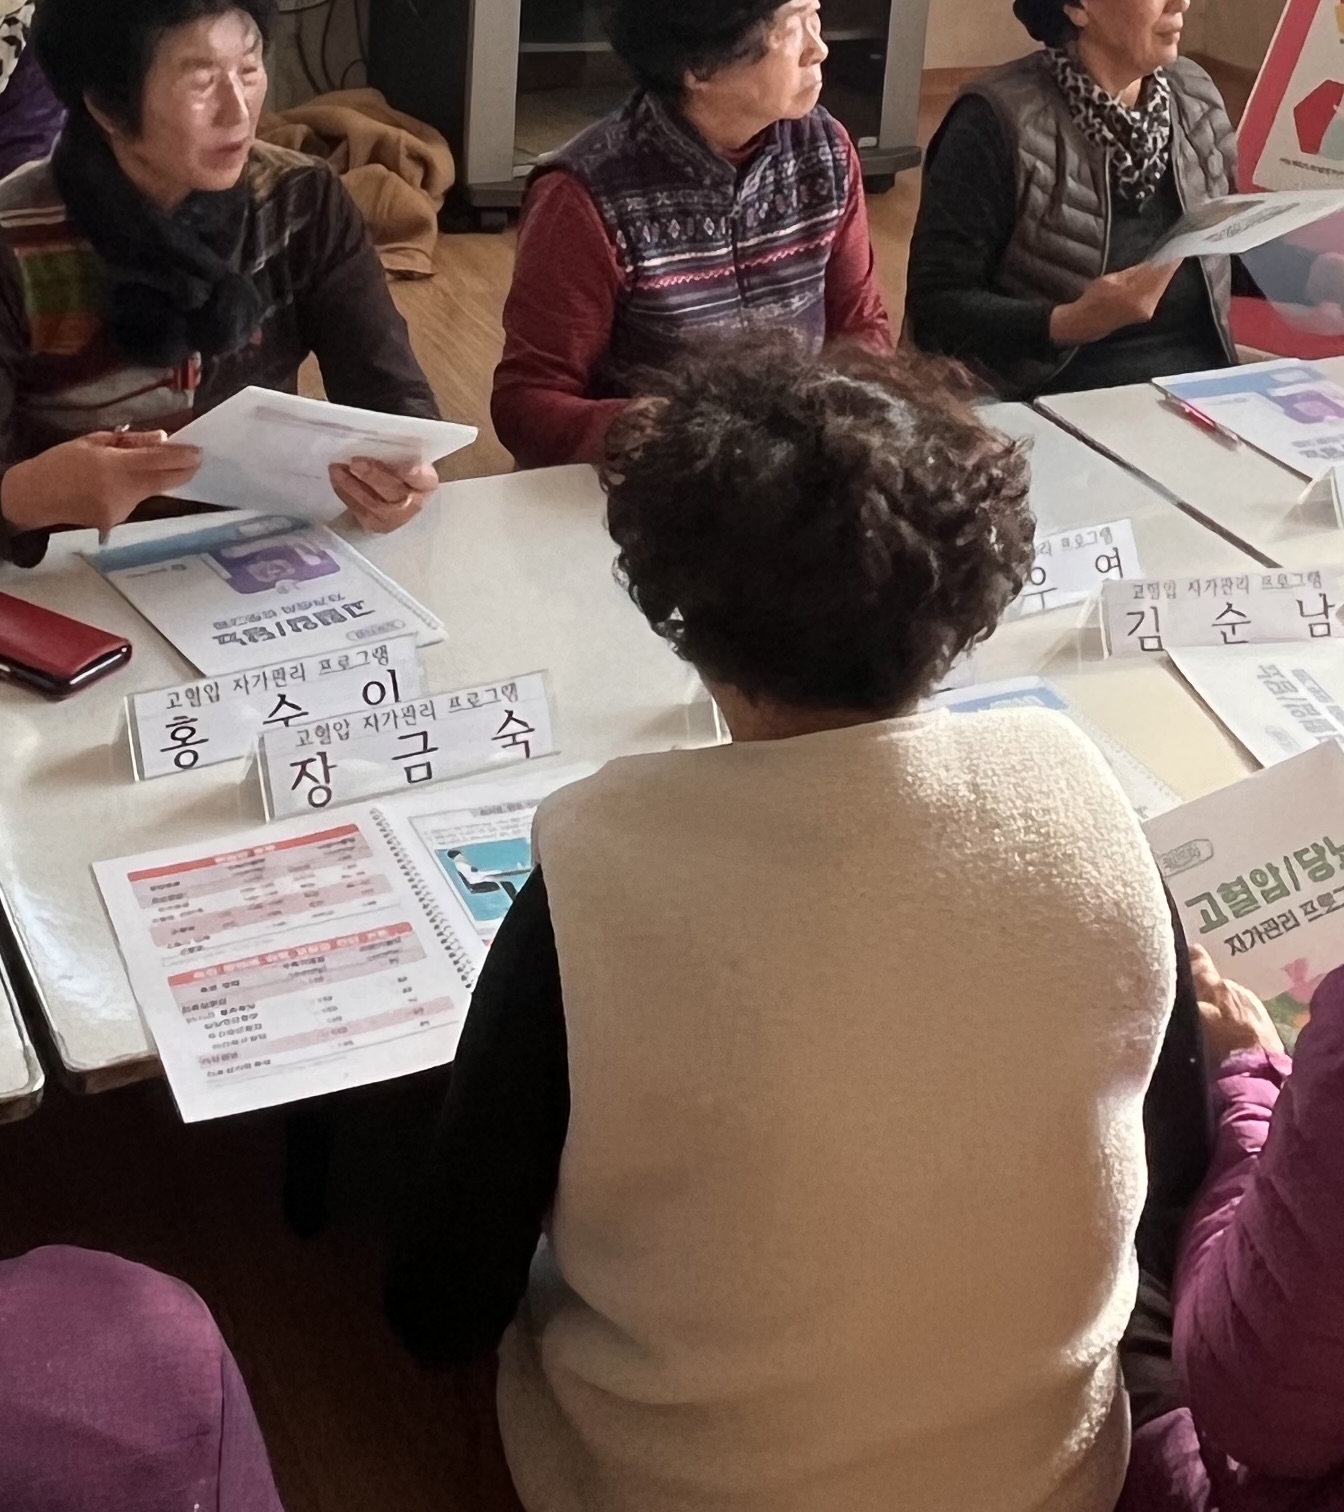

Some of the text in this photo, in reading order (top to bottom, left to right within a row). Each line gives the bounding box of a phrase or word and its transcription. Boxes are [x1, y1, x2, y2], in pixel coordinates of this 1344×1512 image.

[1126, 593, 1336, 652] 김 순 남
[160, 715, 210, 770] 홍
[289, 709, 536, 808] 장 금 숙
